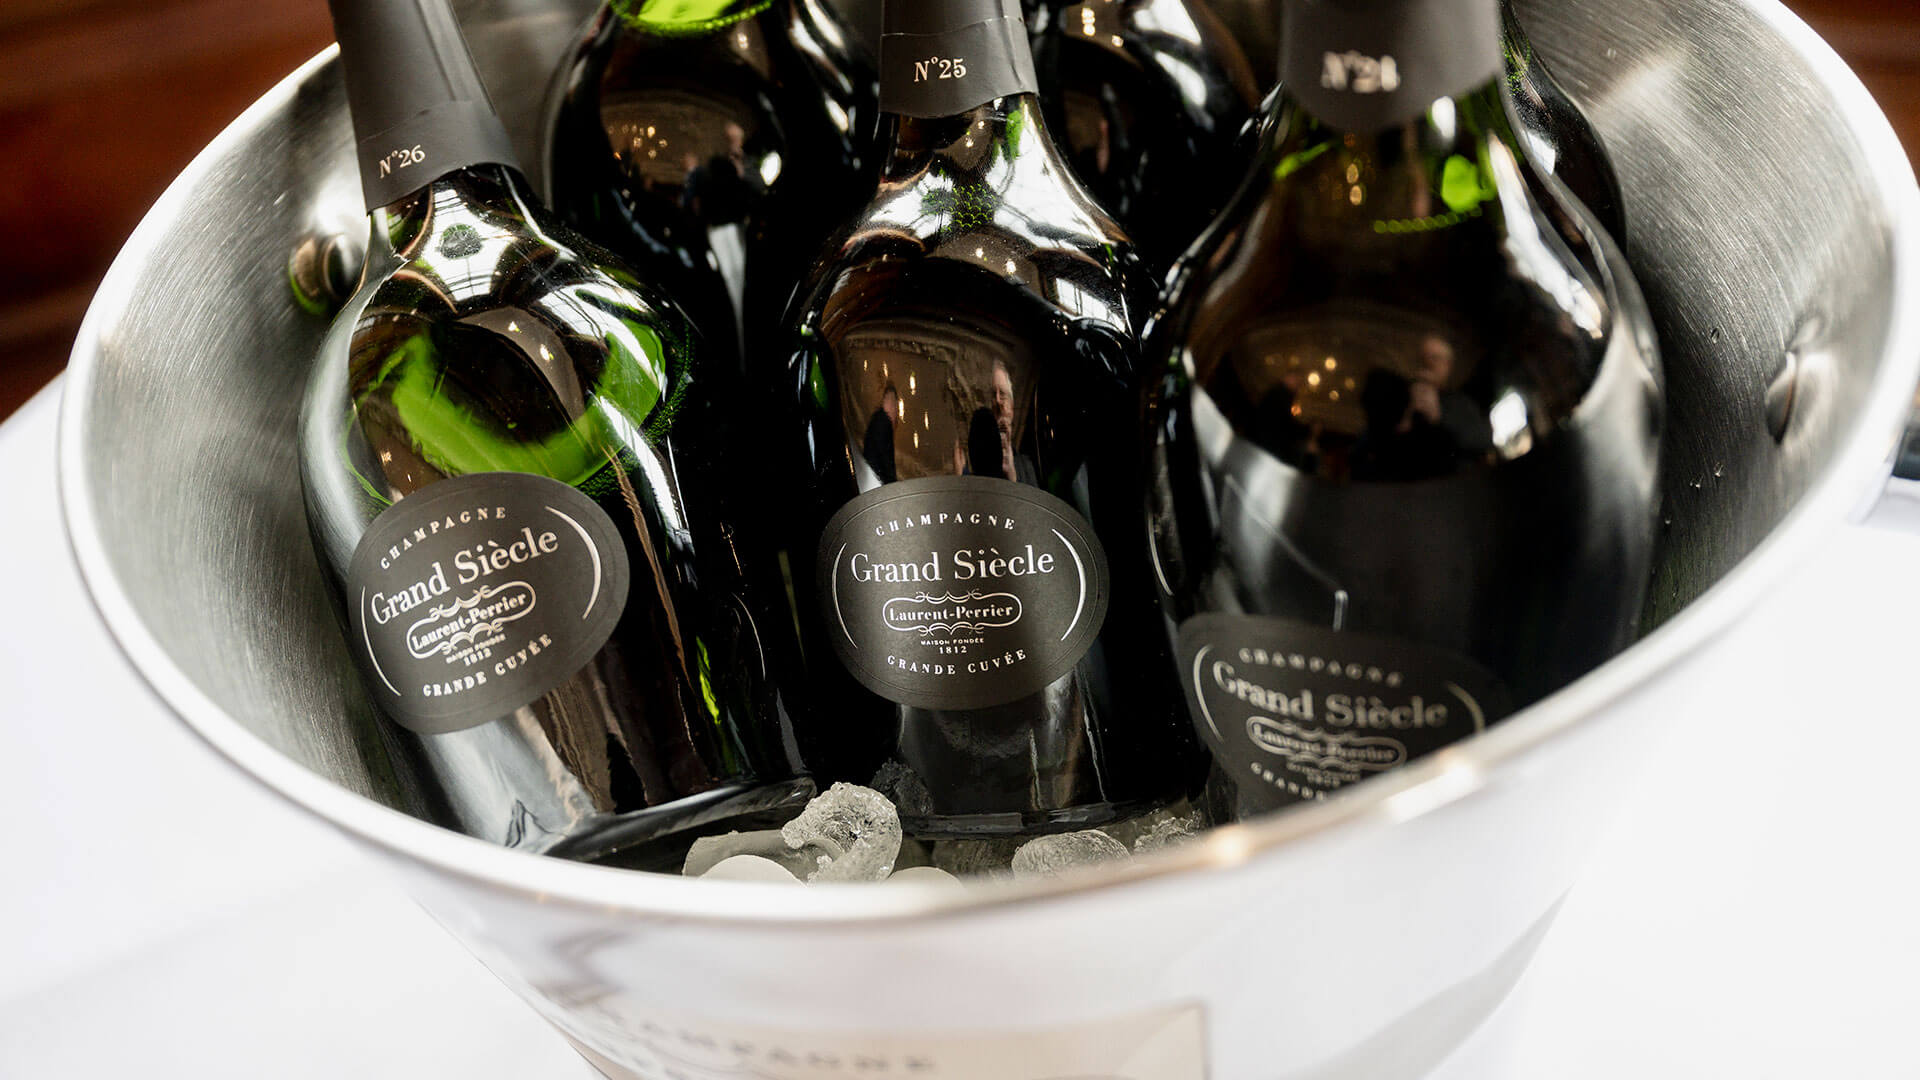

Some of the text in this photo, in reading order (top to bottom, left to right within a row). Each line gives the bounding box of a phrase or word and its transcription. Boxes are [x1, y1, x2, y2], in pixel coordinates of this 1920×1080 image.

[380, 507, 506, 570] CHAMPAGNE
[876, 512, 1015, 536] CHAMPAGNE
[371, 527, 559, 625] Grand Siècle
[851, 544, 1055, 583] Grand Siècle
[411, 591, 527, 651] Laurent-Perrier
[889, 604, 1013, 622] Laurent-Perrier
[939, 645, 967, 654] 1812
[953, 637, 984, 645] FONDÉE
[422, 634, 552, 697] GRANDE CUVÉE
[887, 648, 1026, 675] GRANDE CUVÉE
[1212, 660, 1449, 728] Grand Siècle
